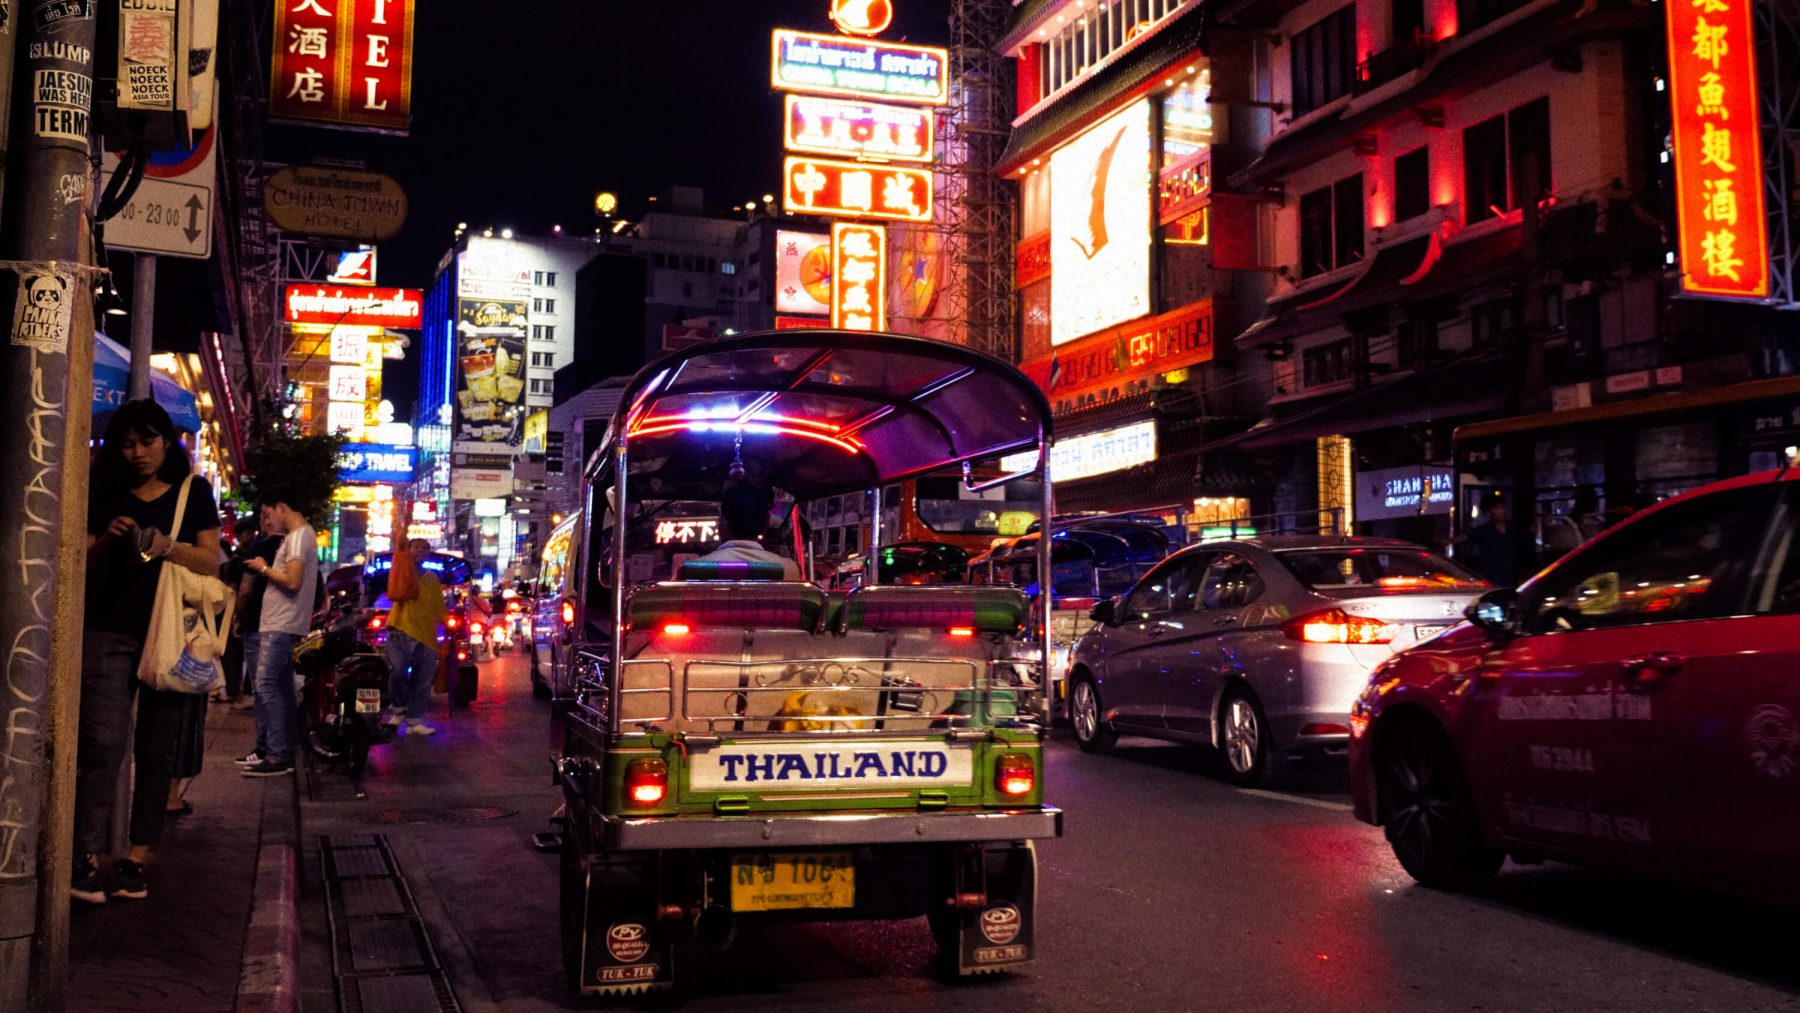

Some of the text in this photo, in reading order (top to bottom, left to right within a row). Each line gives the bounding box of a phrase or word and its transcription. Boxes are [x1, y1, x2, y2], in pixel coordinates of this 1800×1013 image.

[129, 65, 168, 75] NOECK
[39, 71, 91, 97] JAESUN
[130, 75, 168, 84] NOECK
[39, 88, 67, 103] WAS
[131, 85, 169, 94] NOECK
[271, 188, 400, 217] CHINA TOWN
[146, 203, 162, 224] 23
[305, 213, 364, 231] HOTEL
[365, 453, 413, 471] TRAVEL
[719, 752, 947, 782] THAILAND
